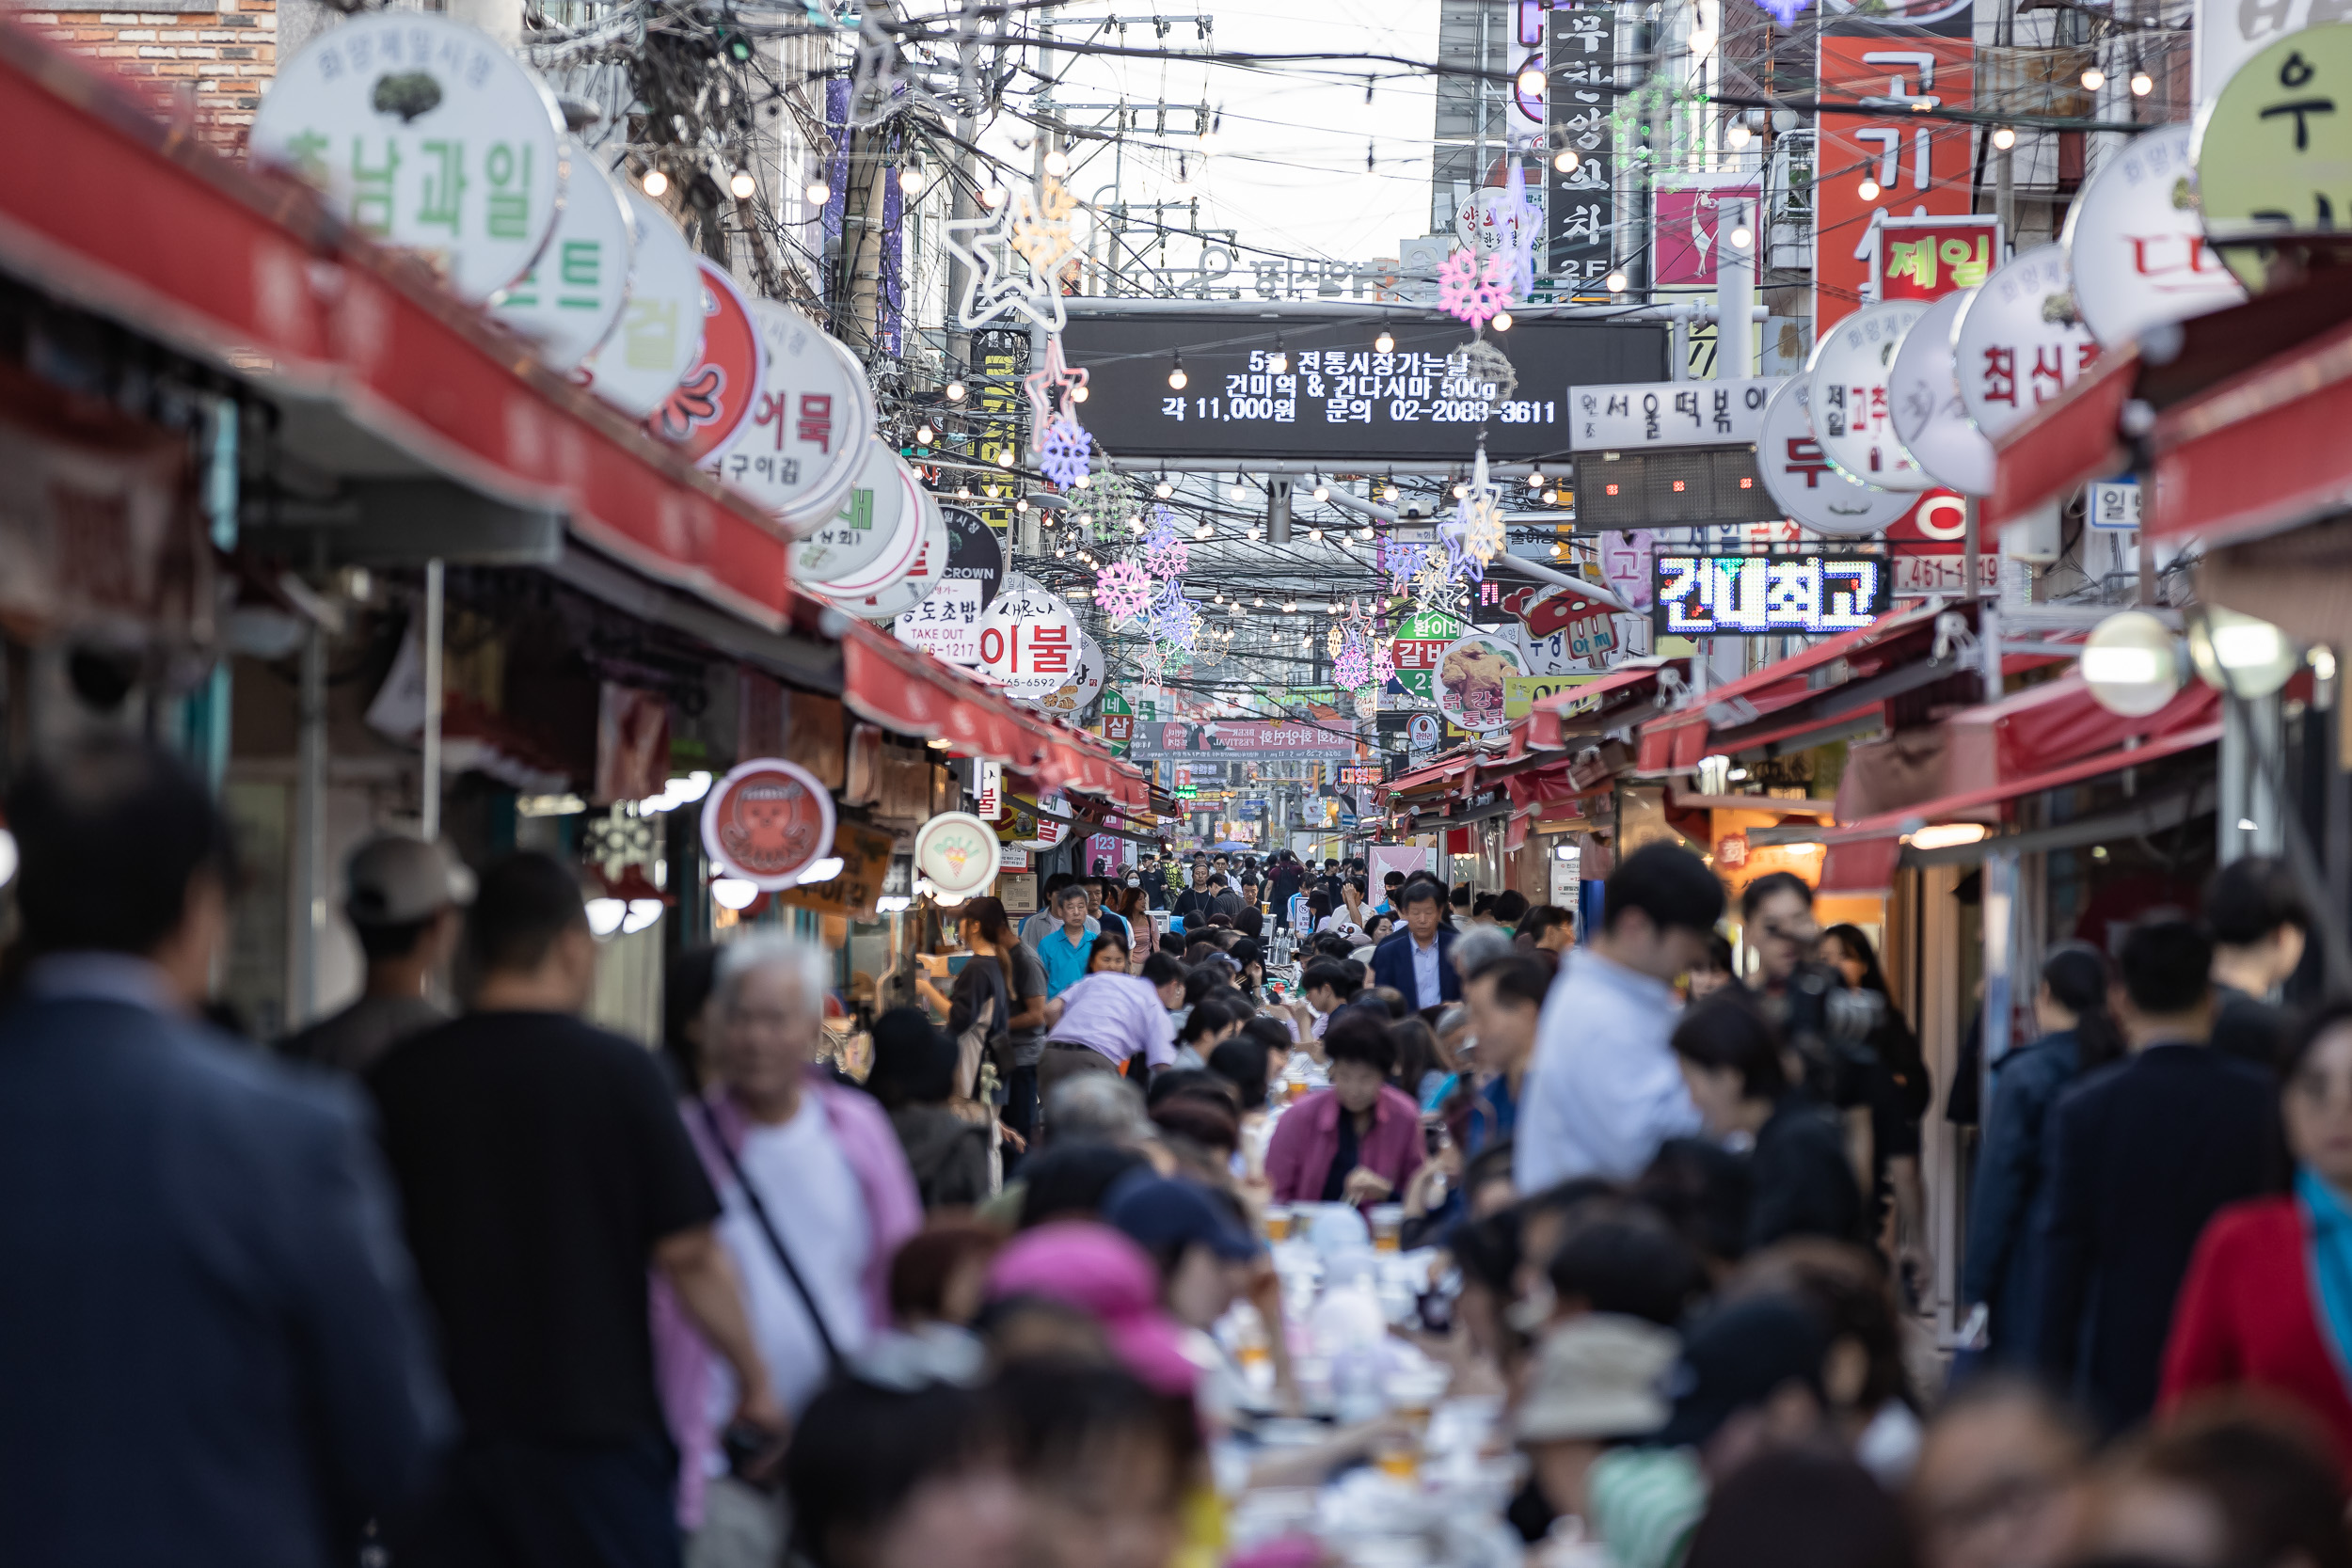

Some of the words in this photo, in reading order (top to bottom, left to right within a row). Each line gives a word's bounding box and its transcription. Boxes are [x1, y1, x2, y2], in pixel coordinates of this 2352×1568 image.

[1559, 259, 1608, 278] 2F
[1886, 234, 1989, 290] 제일
[1297, 350, 1470, 376] 전통시장가는날
[1225, 374, 1297, 399] 건미역
[1307, 376, 1325, 397] &
[1333, 374, 1433, 400] 건다시마
[1439, 377, 1497, 401] 500g
[1162, 397, 1186, 421] 각
[1196, 397, 1296, 422] 11,000원
[1325, 398, 1372, 423] 문의
[942, 567, 994, 579] CROWN
[1892, 560, 1998, 588] T.461-119
[911, 628, 939, 641] TAKE
[944, 628, 965, 640] OUT
[980, 625, 1073, 673] 이불
[1094, 832, 1116, 851] 123
